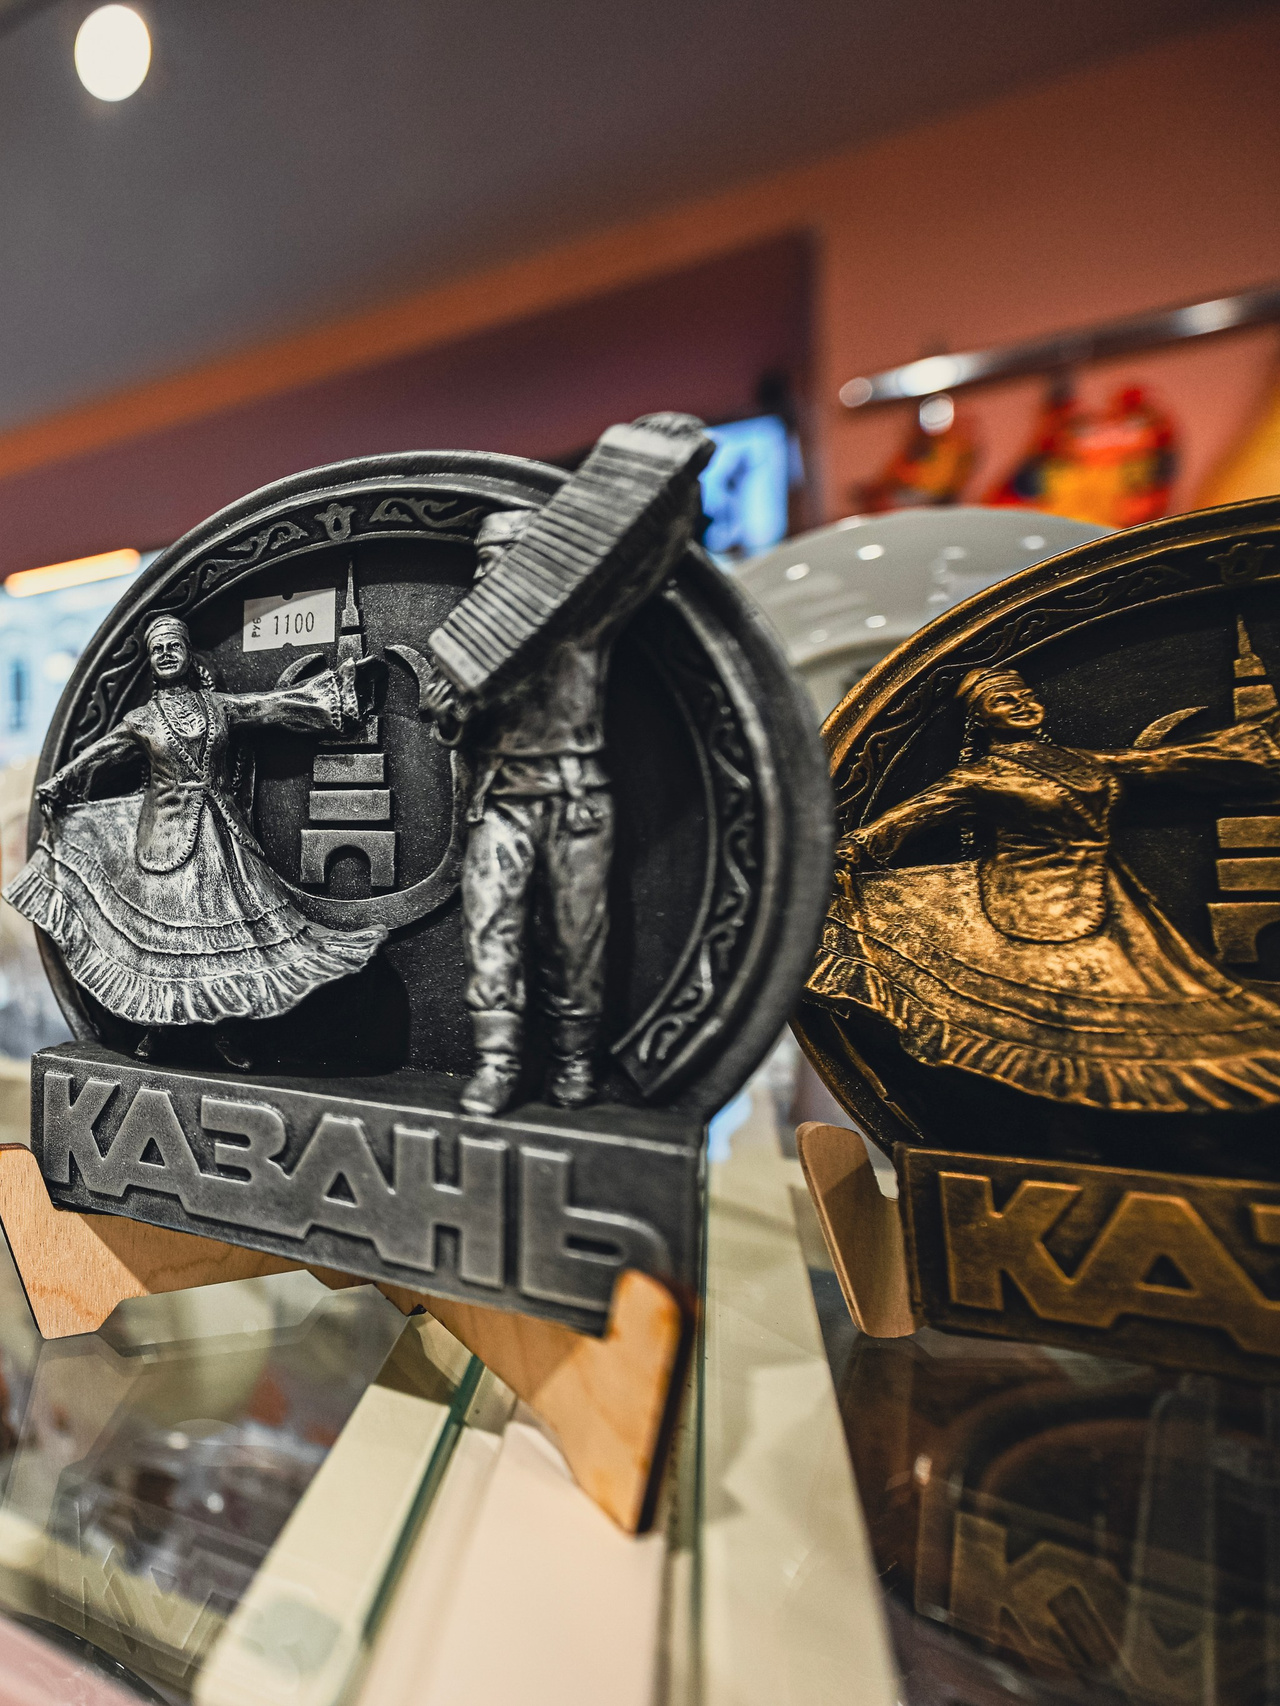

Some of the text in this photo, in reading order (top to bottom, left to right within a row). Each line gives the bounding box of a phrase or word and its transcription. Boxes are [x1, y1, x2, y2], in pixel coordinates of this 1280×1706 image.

[273, 611, 315, 636] 1100
[42, 1070, 671, 1310] КАЗАНЬ
[937, 1170, 1280, 1358] КА
